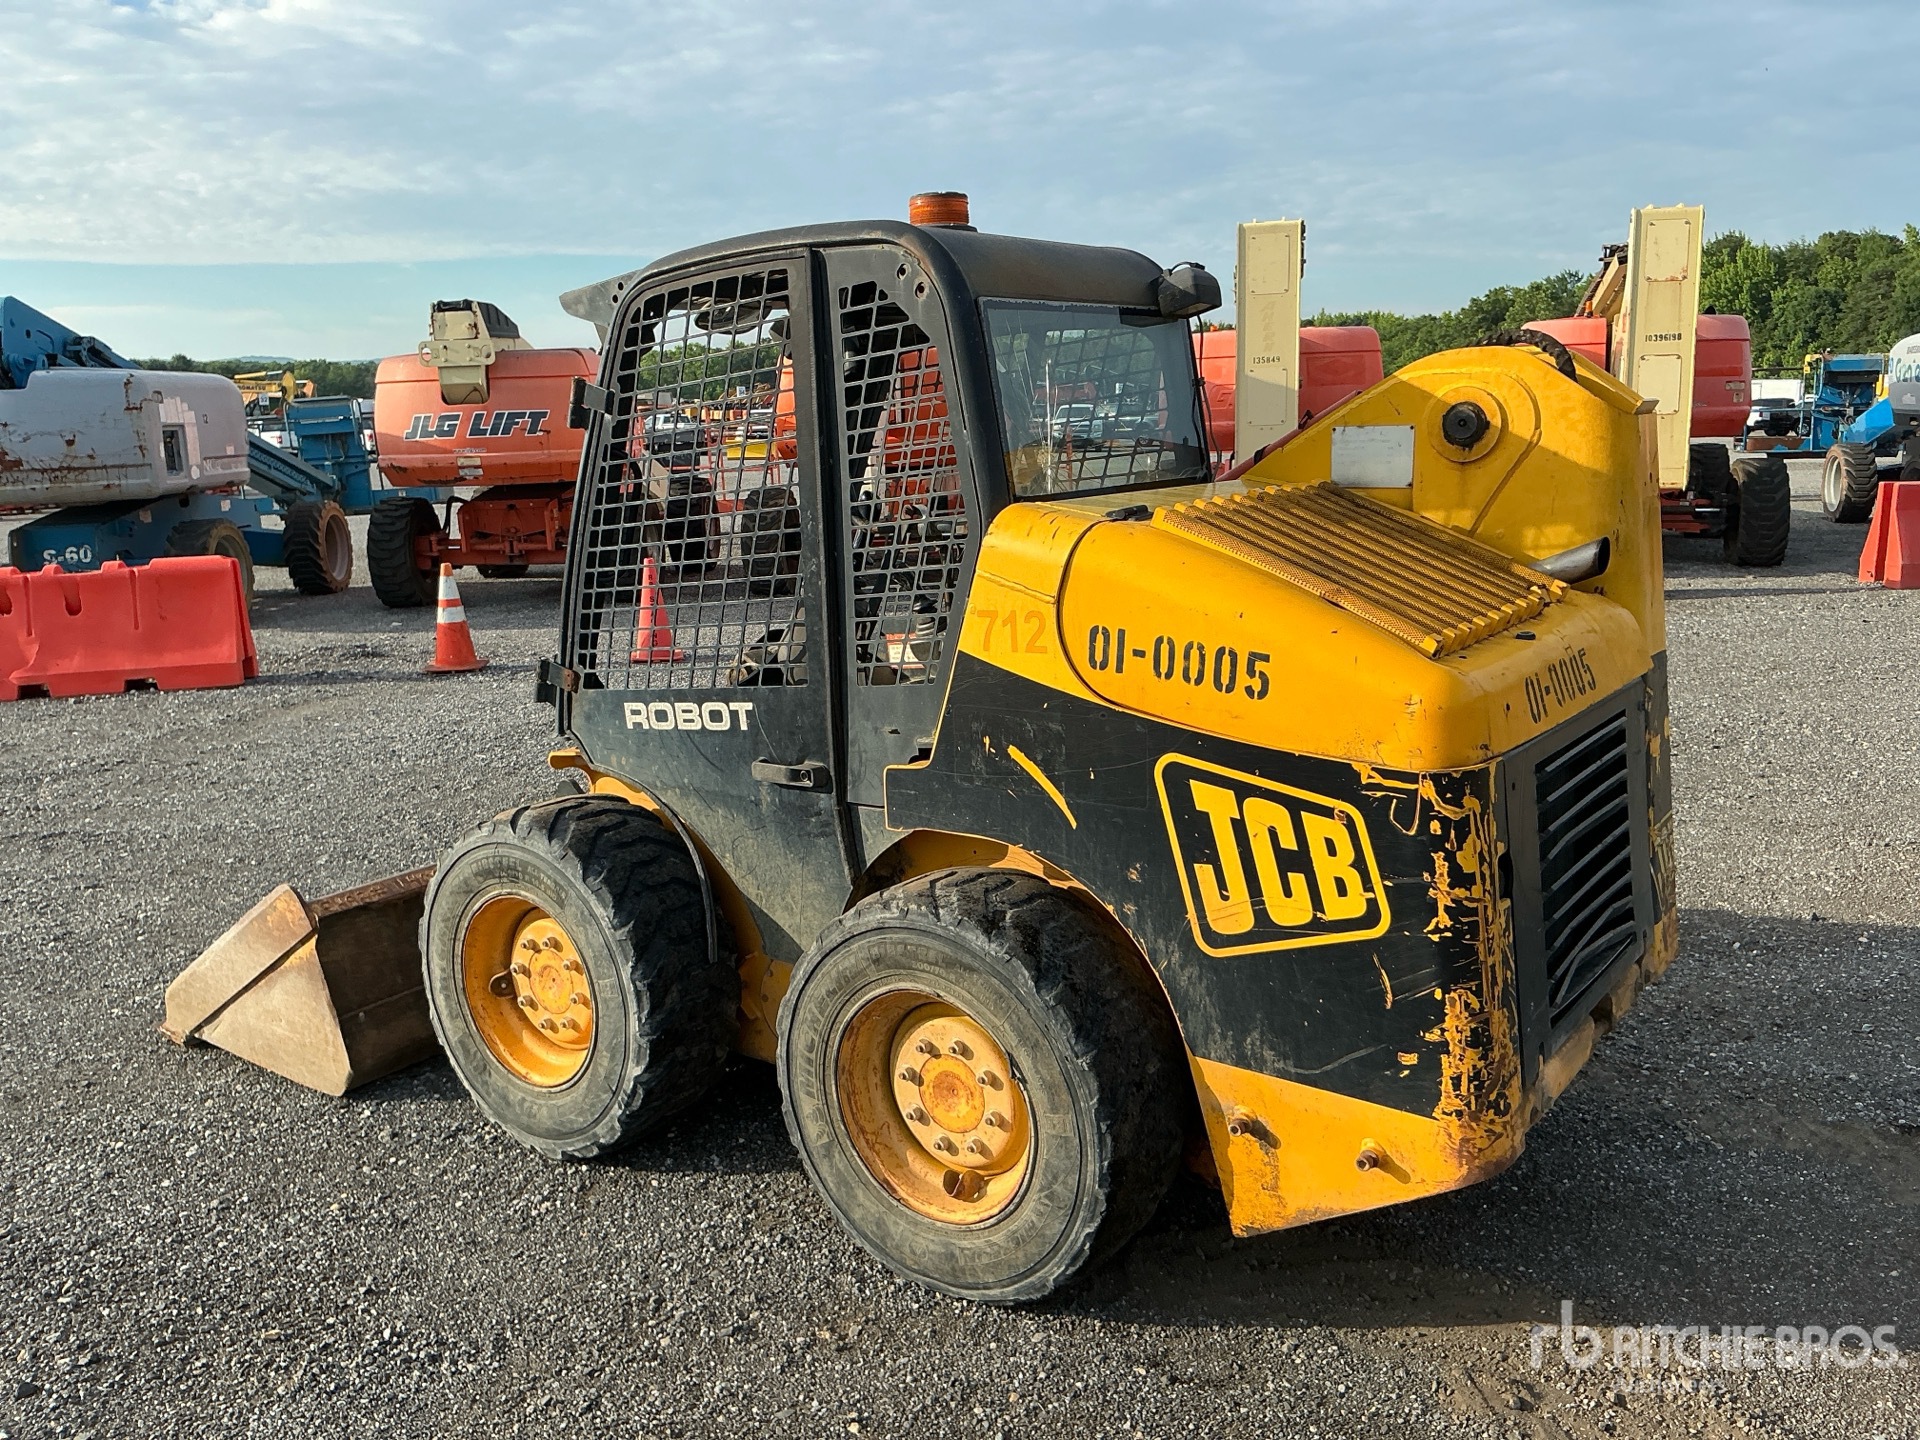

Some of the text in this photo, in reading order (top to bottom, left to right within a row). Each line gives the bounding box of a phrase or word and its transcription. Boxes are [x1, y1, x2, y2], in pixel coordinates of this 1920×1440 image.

[1645, 333, 1682, 342] 10396198
[1253, 355, 1281, 364] 135849
[404, 410, 550, 441] JLG LIFT
[43, 544, 92, 565] S-60
[976, 609, 1048, 653] 712
[623, 702, 753, 731] ROBOT
[1189, 779, 1368, 935] JCB
